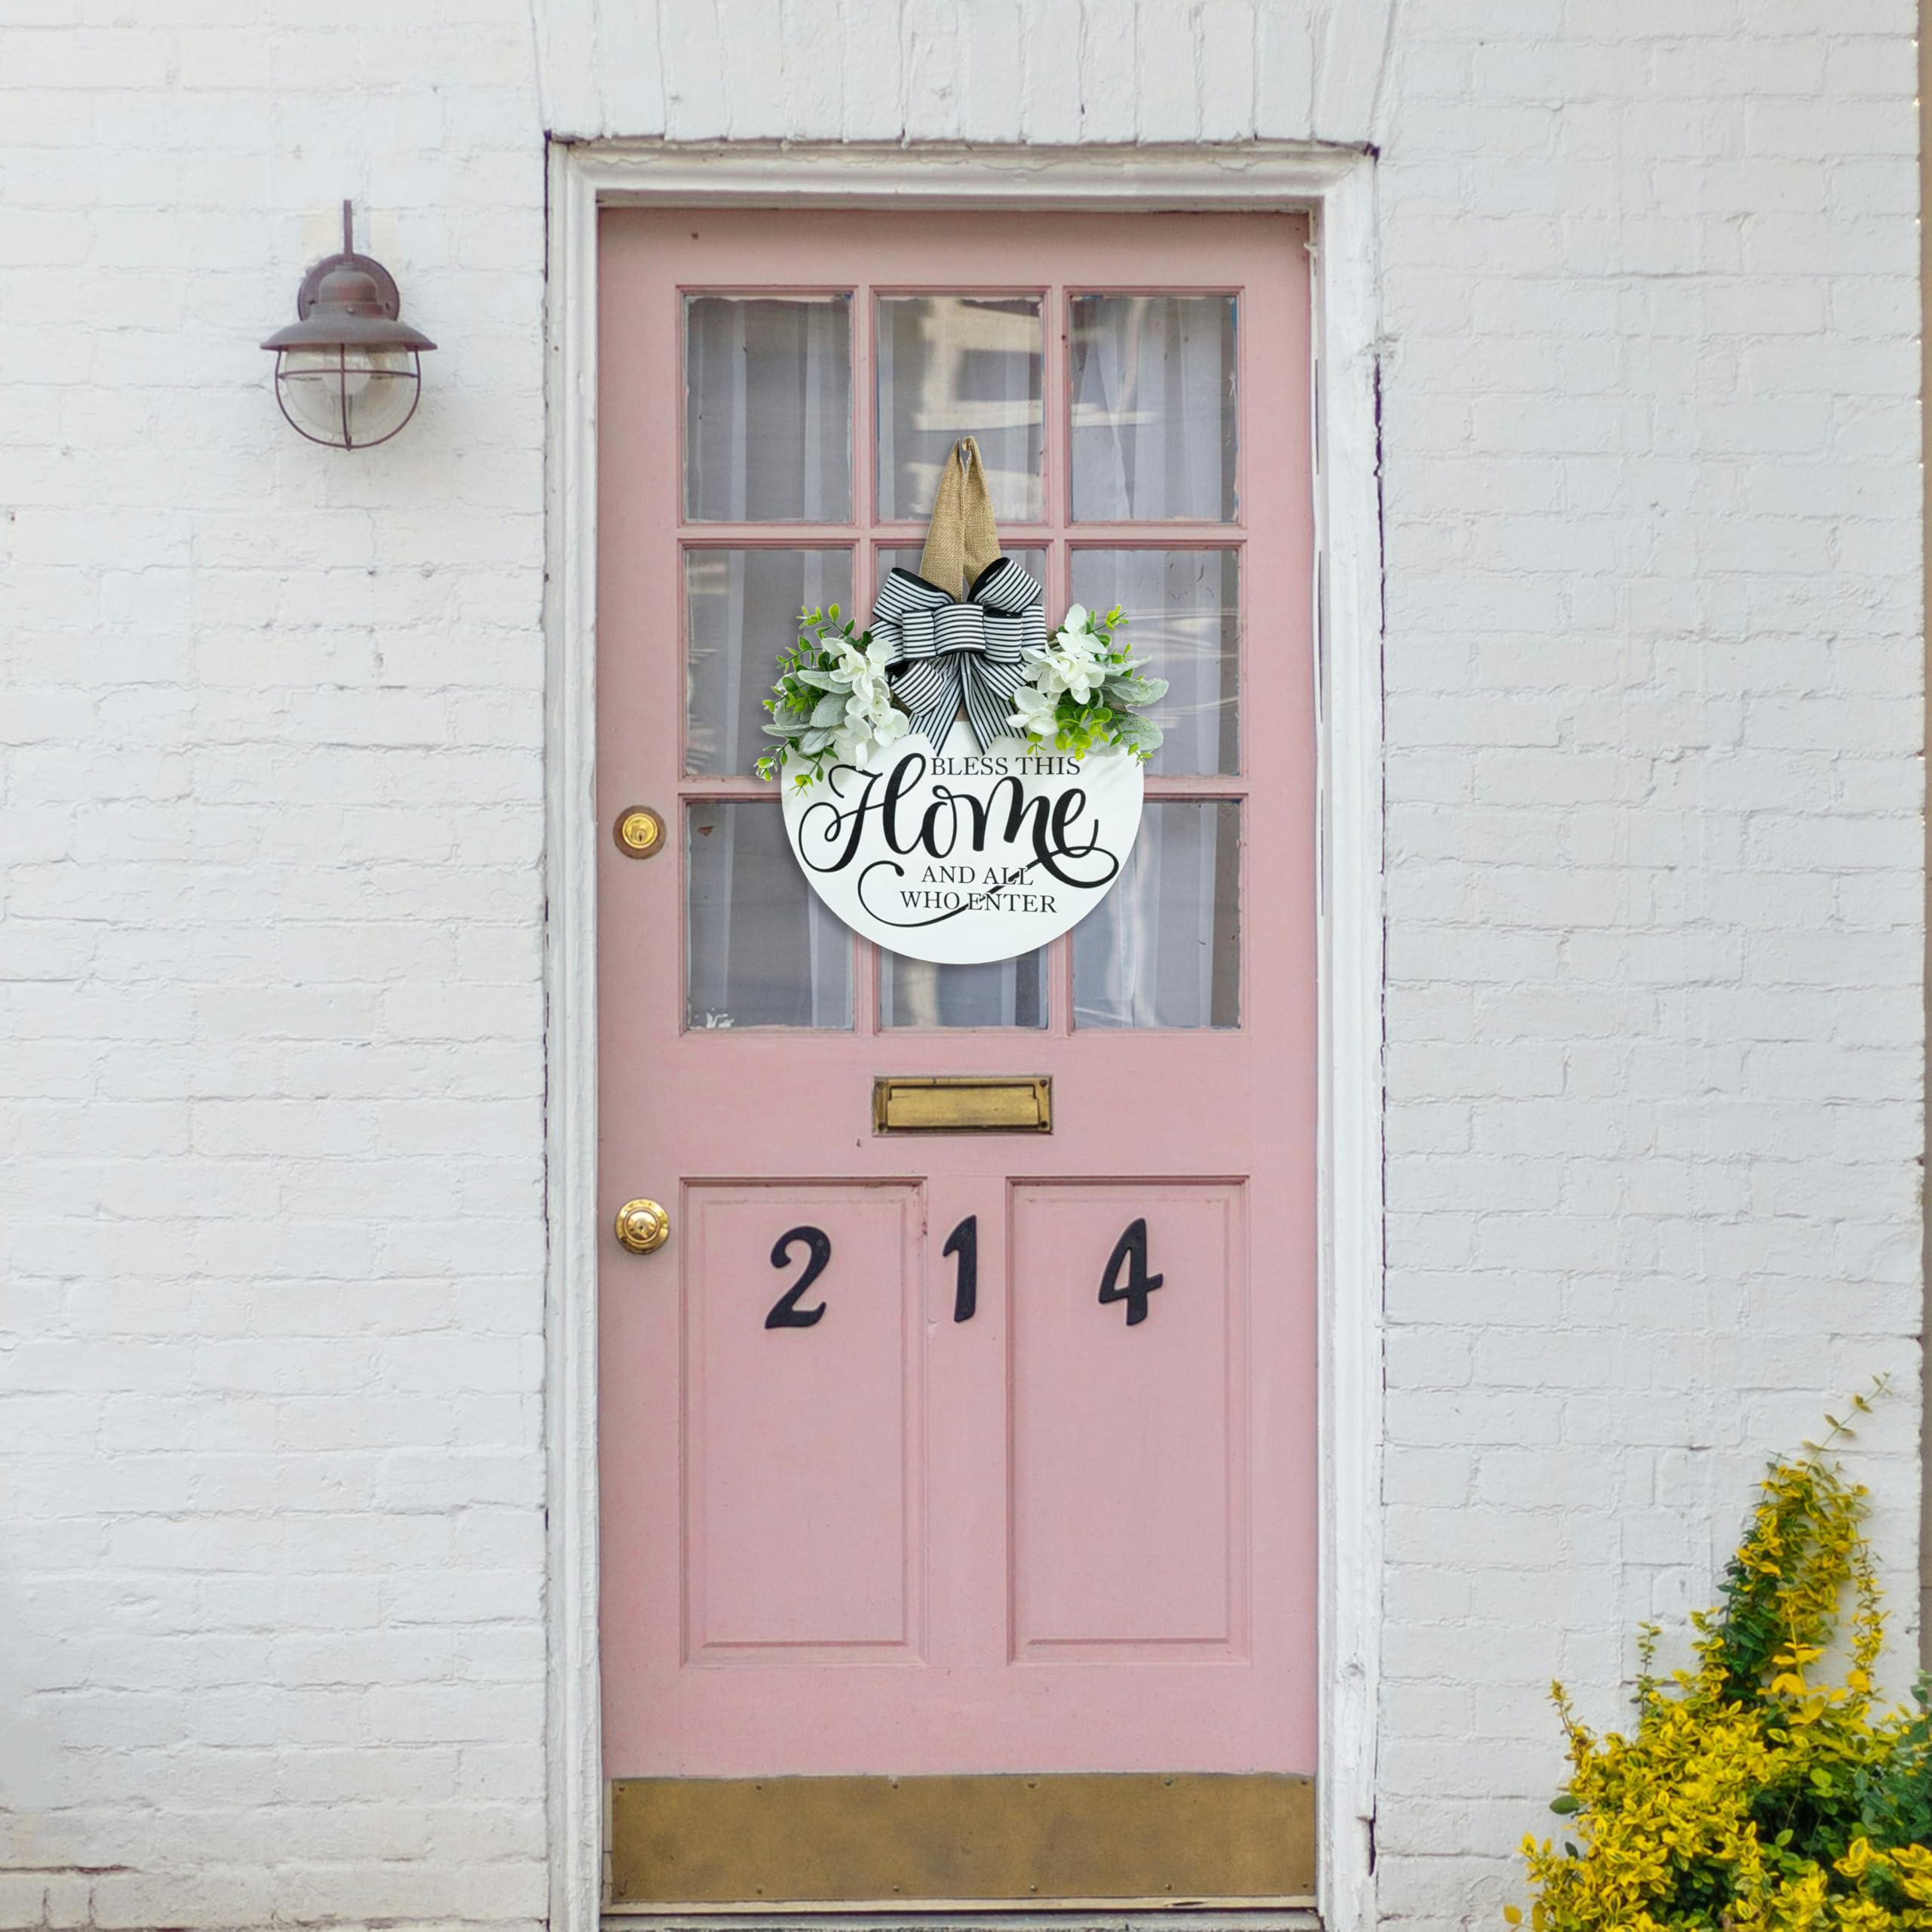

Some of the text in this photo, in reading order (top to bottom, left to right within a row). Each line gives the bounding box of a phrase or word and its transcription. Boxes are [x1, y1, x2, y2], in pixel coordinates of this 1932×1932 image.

[931, 756, 1081, 776] BLESS THIS
[798, 752, 1119, 889] Home
[921, 866, 1034, 886] AND ALL
[901, 891, 1057, 913] WHO ENTER
